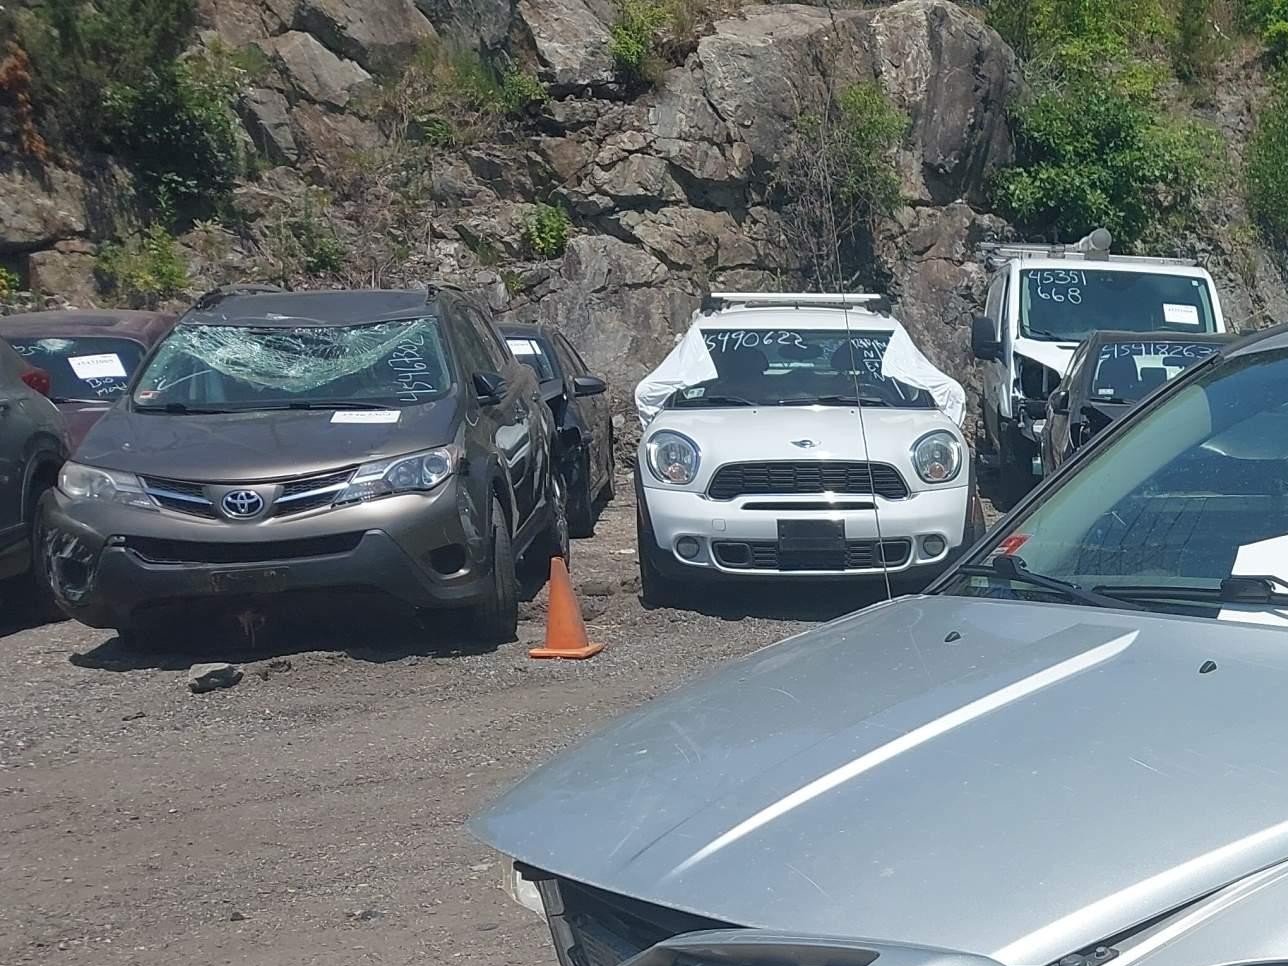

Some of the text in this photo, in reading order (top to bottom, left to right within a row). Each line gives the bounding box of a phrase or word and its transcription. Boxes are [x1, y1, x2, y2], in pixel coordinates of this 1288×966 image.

[1028, 270, 1087, 286] 45351
[1037, 286, 1082, 304] 668
[702, 330, 808, 353] 5490622
